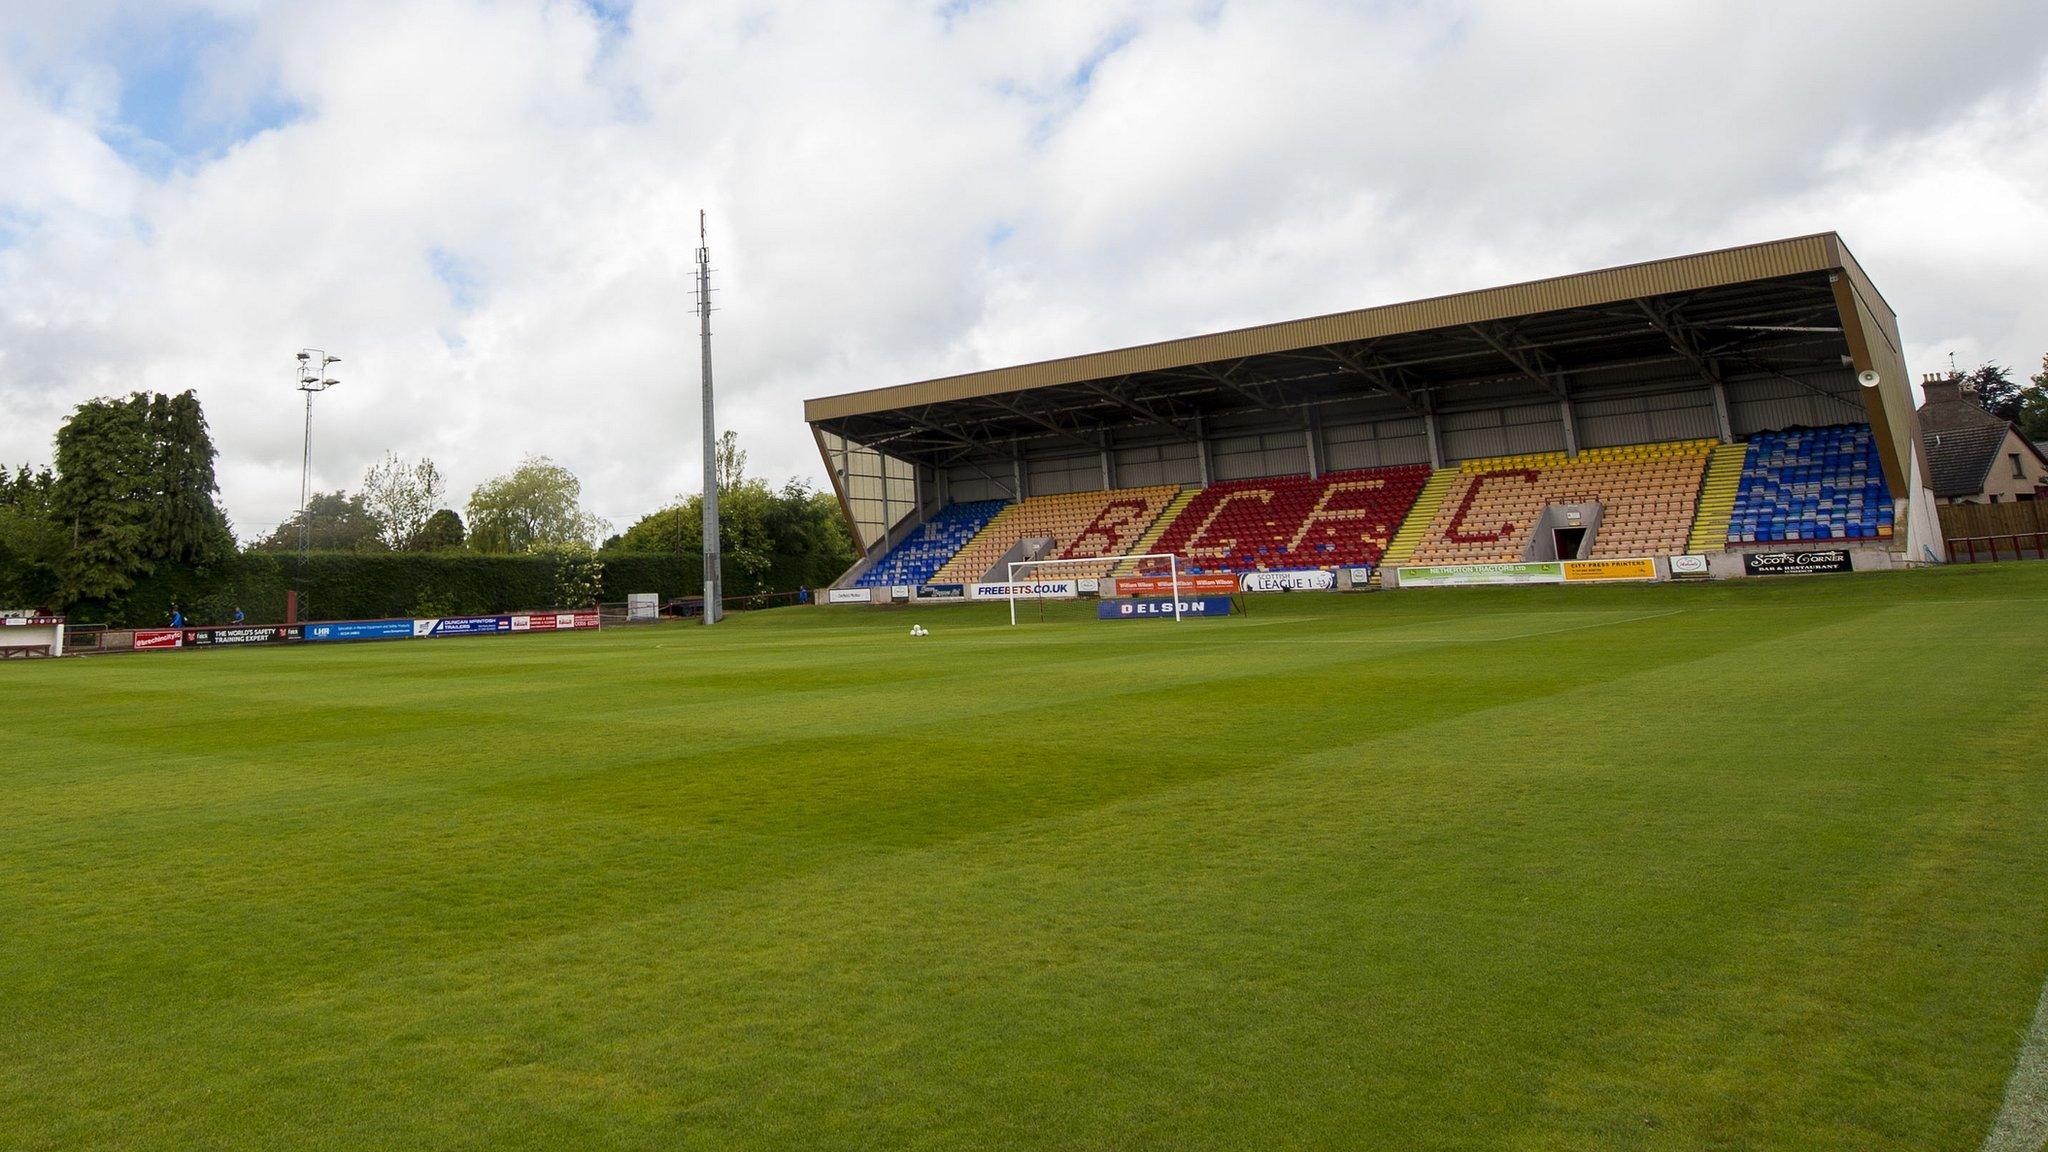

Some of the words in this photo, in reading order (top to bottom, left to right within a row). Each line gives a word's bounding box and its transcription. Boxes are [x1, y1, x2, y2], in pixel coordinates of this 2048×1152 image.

[1751, 553, 1795, 567] SCOT'S
[1797, 553, 1845, 565] CORNER
[1258, 578, 1303, 589] LEAGUE
[1307, 578, 1313, 588] 1
[978, 584, 1068, 595] FREEBETS.CO.UK
[1121, 602, 1205, 614] DELSON
[227, 629, 253, 637] WORLD'S
[254, 628, 276, 636] SAFETY
[215, 636, 244, 644] TRAINING
